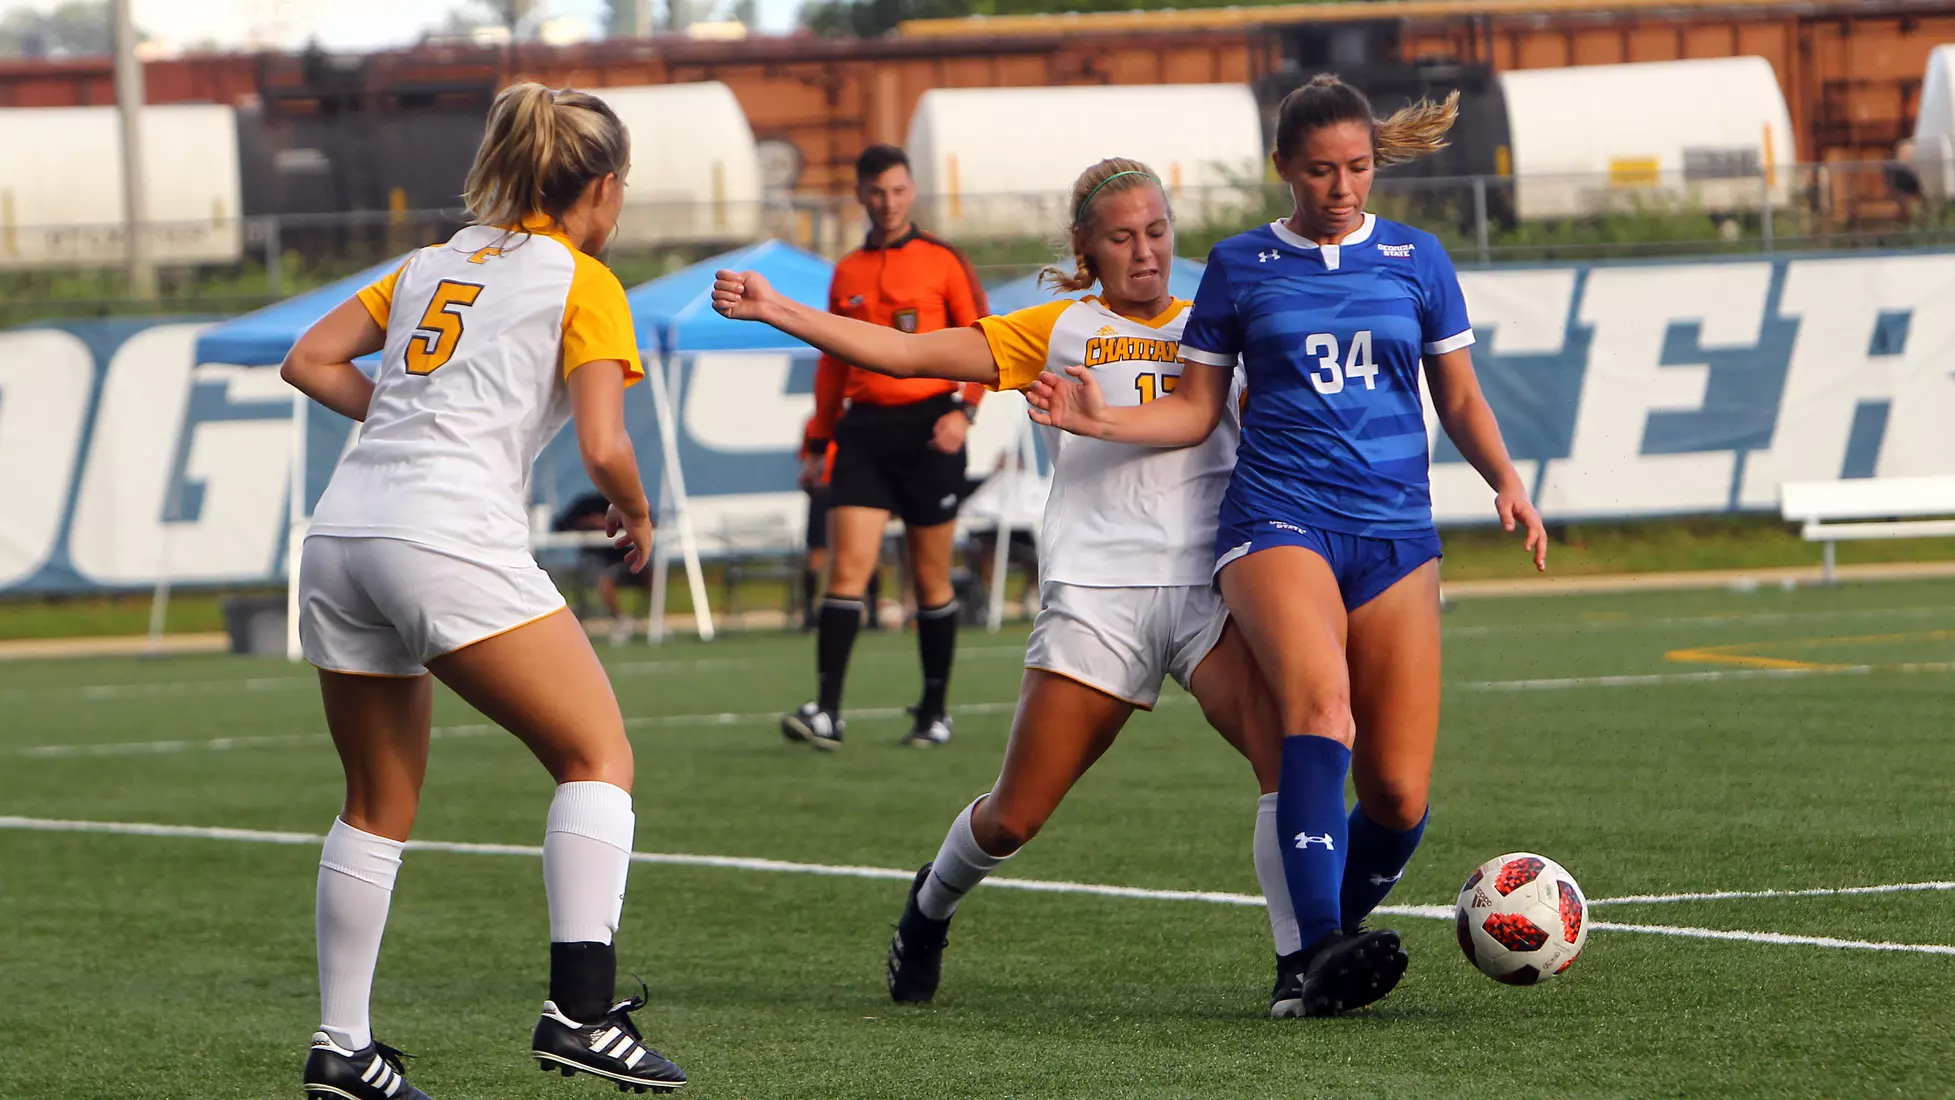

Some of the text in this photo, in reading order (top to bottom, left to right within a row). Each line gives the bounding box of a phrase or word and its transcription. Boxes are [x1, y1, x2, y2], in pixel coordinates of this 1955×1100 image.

[1377, 243, 1415, 251] GEORGIA
[404, 279, 485, 376] 5
[1306, 330, 1379, 395] 34
